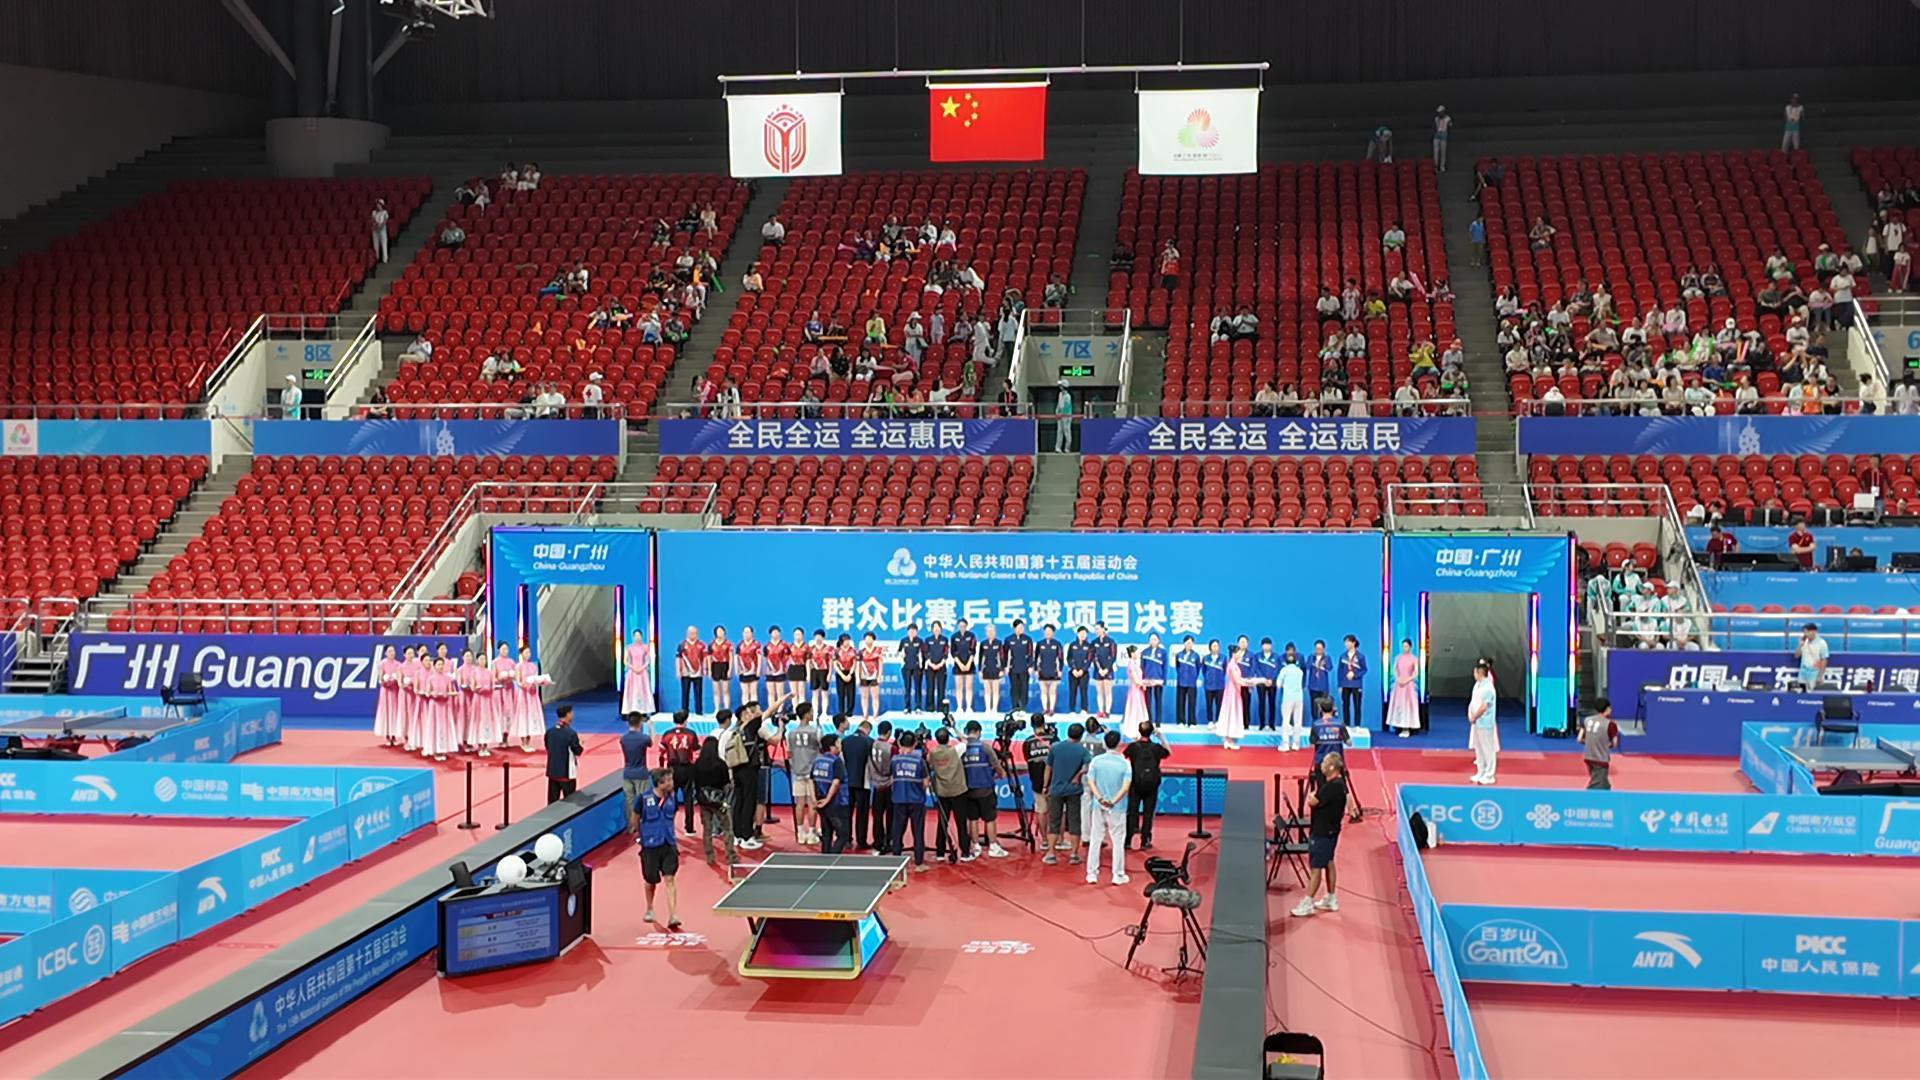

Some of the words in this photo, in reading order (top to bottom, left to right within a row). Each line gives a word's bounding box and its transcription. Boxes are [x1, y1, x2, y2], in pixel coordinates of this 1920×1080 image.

[304, 344, 332, 362] 8区
[1062, 340, 1091, 358] 7区
[728, 421, 840, 449] 全民全运
[851, 421, 965, 449] 全运惠民
[1148, 422, 1267, 451] 全民全运
[1279, 422, 1400, 451] 全运惠民
[533, 543, 609, 560] 中国·广州
[1436, 548, 1521, 566] 中国·广州
[924, 553, 1137, 570] 中华人民共和国第十五届运动会
[925, 571, 938, 579] The
[958, 571, 988, 579] National
[991, 571, 1016, 579] Games
[1027, 572, 1039, 580] the
[1073, 572, 1105, 581] Republic
[74, 643, 179, 689] 广州
[193, 645, 384, 700] Guangz
[182, 779, 228, 792] 中国移动
[1670, 811, 1728, 828] 中国电信
[1787, 814, 1856, 827] 中国南方航空
[1481, 926, 1537, 942] 百岁山
[1796, 934, 1847, 955] PICC
[37, 941, 78, 980] ICBC
[1632, 951, 1675, 968] ANTA
[1762, 958, 1881, 977] 中国人民保险
[275, 924, 407, 1017] 中华人民共和国第十五届运动会
